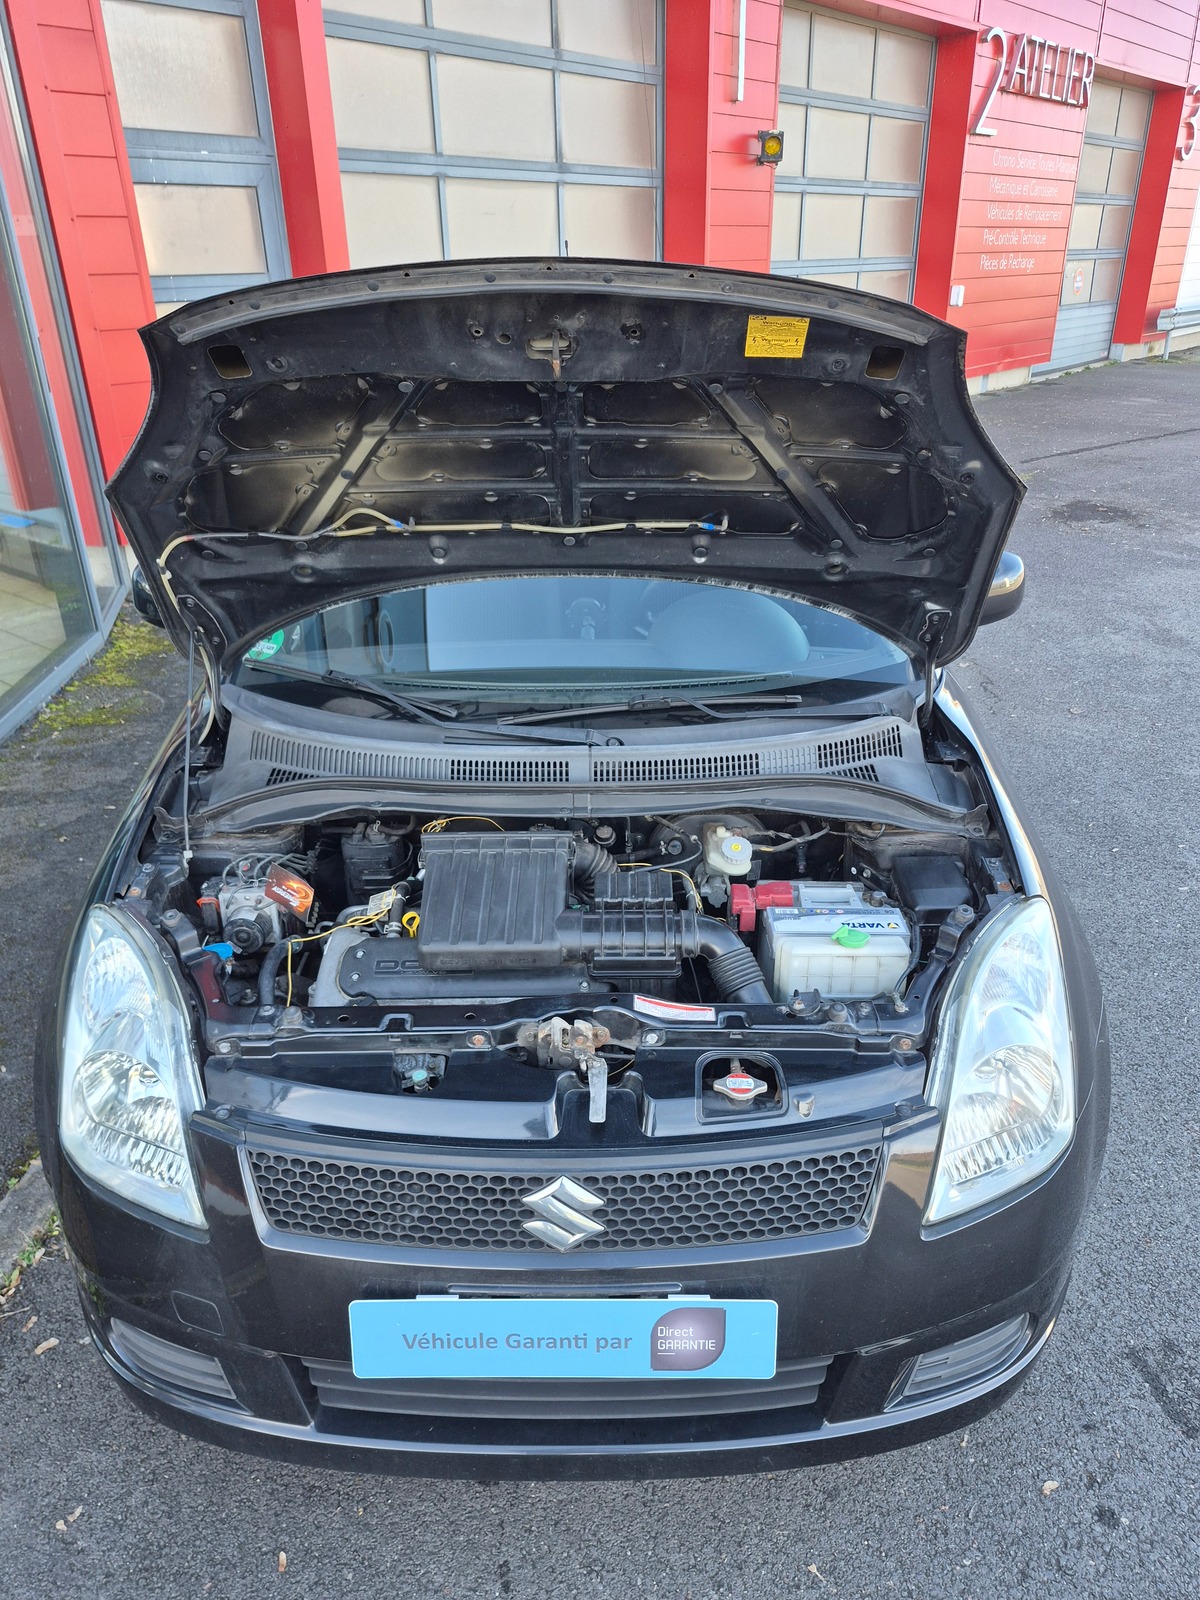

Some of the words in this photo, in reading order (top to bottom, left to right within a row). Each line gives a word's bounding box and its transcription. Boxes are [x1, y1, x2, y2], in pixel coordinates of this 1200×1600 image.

[973, 27, 1007, 136] 2
[1008, 33, 1096, 106] ATELIER
[1178, 85, 1200, 161] 3
[993, 148, 1016, 167] Chrono
[1017, 151, 1037, 170] Service
[989, 176, 1022, 199] Mécanique
[1022, 183, 1030, 196] et
[987, 202, 1015, 220] Véhicules
[1015, 203, 1023, 220] de
[1023, 204, 1063, 224] Remplacement
[983, 229, 1019, 245] Pré-Contrôle
[1020, 229, 1047, 248] Technique
[980, 254, 999, 271] Pièces
[1000, 253, 1007, 270] de
[1008, 253, 1035, 273] Rechange
[657, 1326, 694, 1337] Direct
[401, 1332, 498, 1350] Véhicule
[505, 1332, 588, 1350] Garanti
[595, 1337, 633, 1353] par
[657, 1339, 716, 1350] GARANTIE
